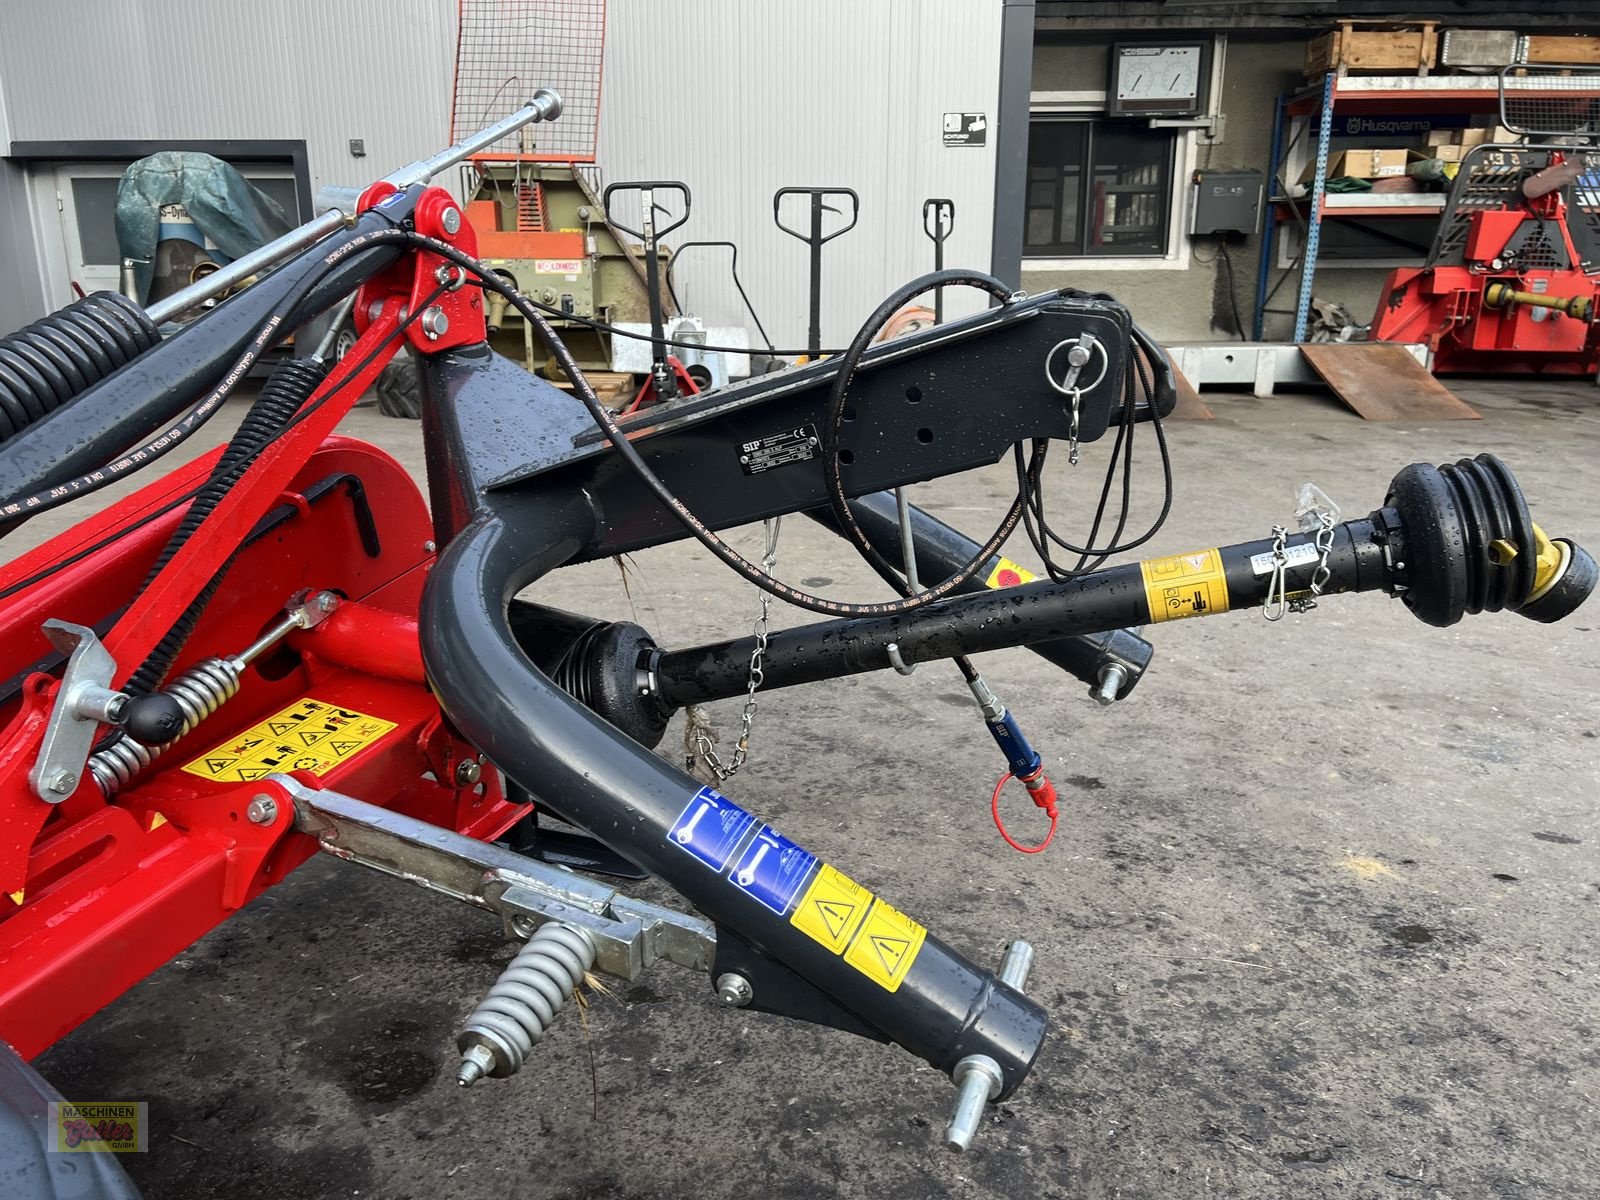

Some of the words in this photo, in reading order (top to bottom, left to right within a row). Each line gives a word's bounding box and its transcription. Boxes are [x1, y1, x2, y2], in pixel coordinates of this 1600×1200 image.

[1361, 119, 1430, 132] Husqvarna
[742, 440, 760, 452] SIP
[134, 452, 148, 462] SAE
[26, 496, 41, 506] WP
[921, 592, 932, 603] SAE
[996, 724, 1008, 737] SIP
